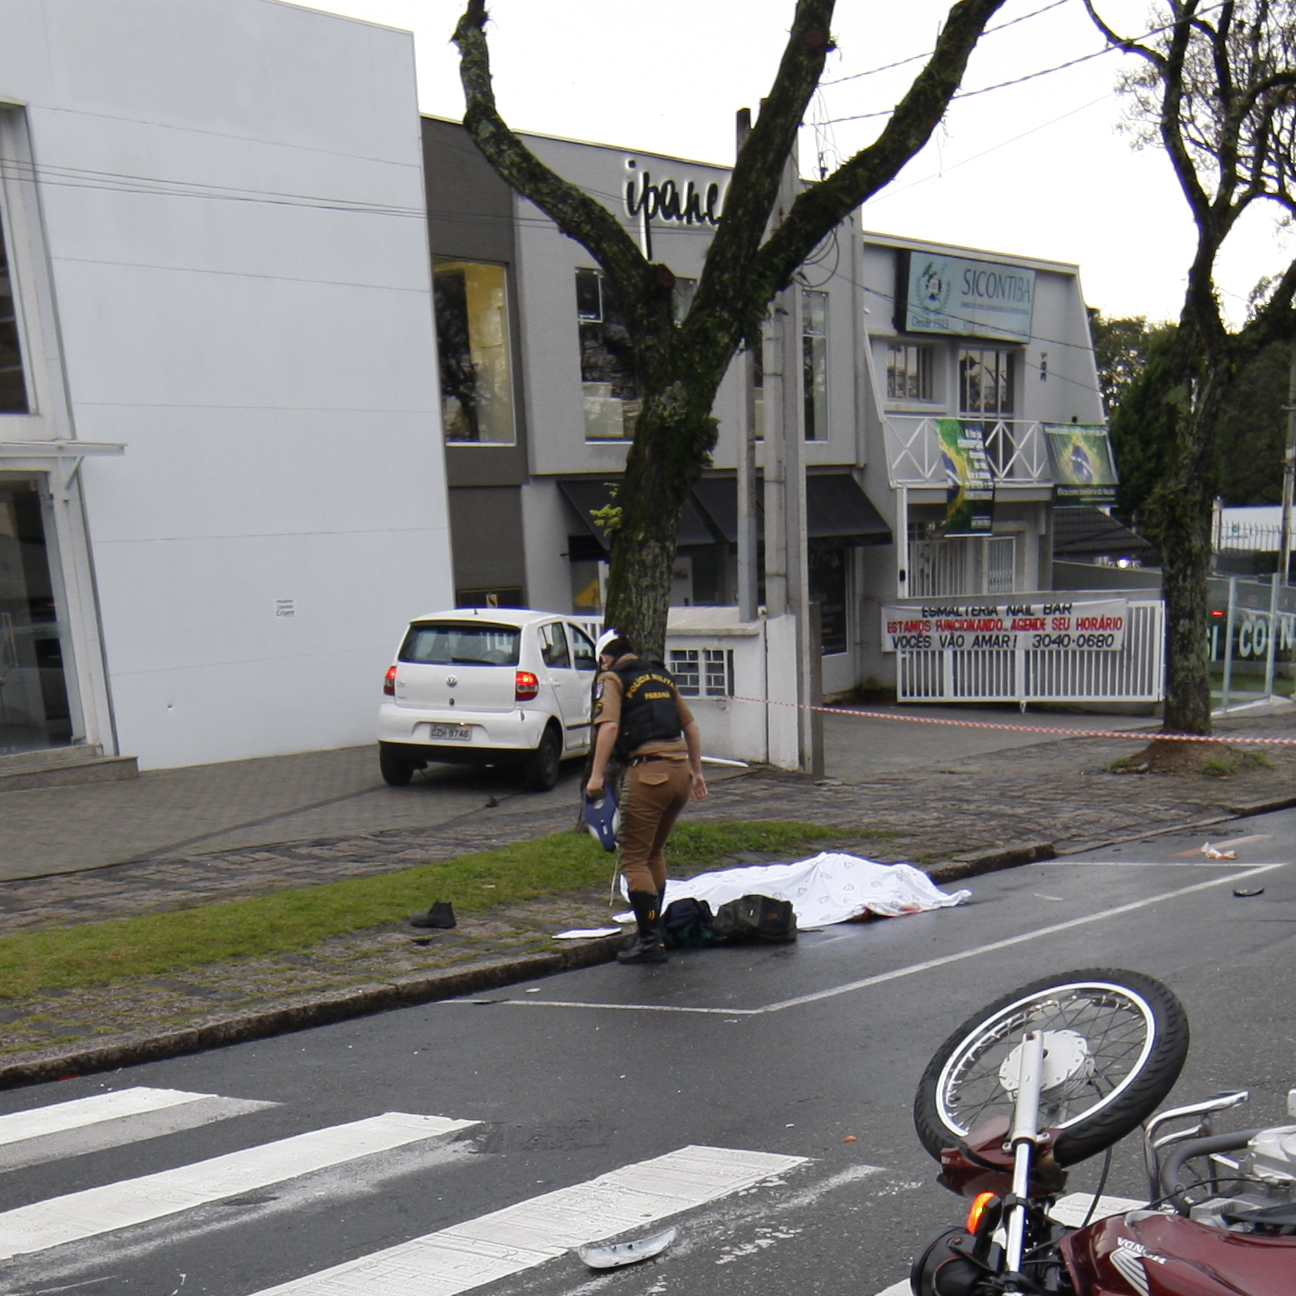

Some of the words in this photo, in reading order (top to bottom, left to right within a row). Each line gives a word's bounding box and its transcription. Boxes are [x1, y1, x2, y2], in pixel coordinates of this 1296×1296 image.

[624, 159, 723, 261] ipane
[961, 268, 1031, 304] SICONTIBA
[921, 604, 998, 618] ESMALTERIA
[1006, 603, 1033, 617] NAIL
[887, 619, 931, 633] ESTAMOS
[1010, 618, 1047, 632] AGENDE
[1051, 617, 1070, 632] SEU
[1075, 614, 1123, 632] HORÁRIO
[892, 632, 932, 649] VOCÊS
[939, 633, 965, 649] VÃO
